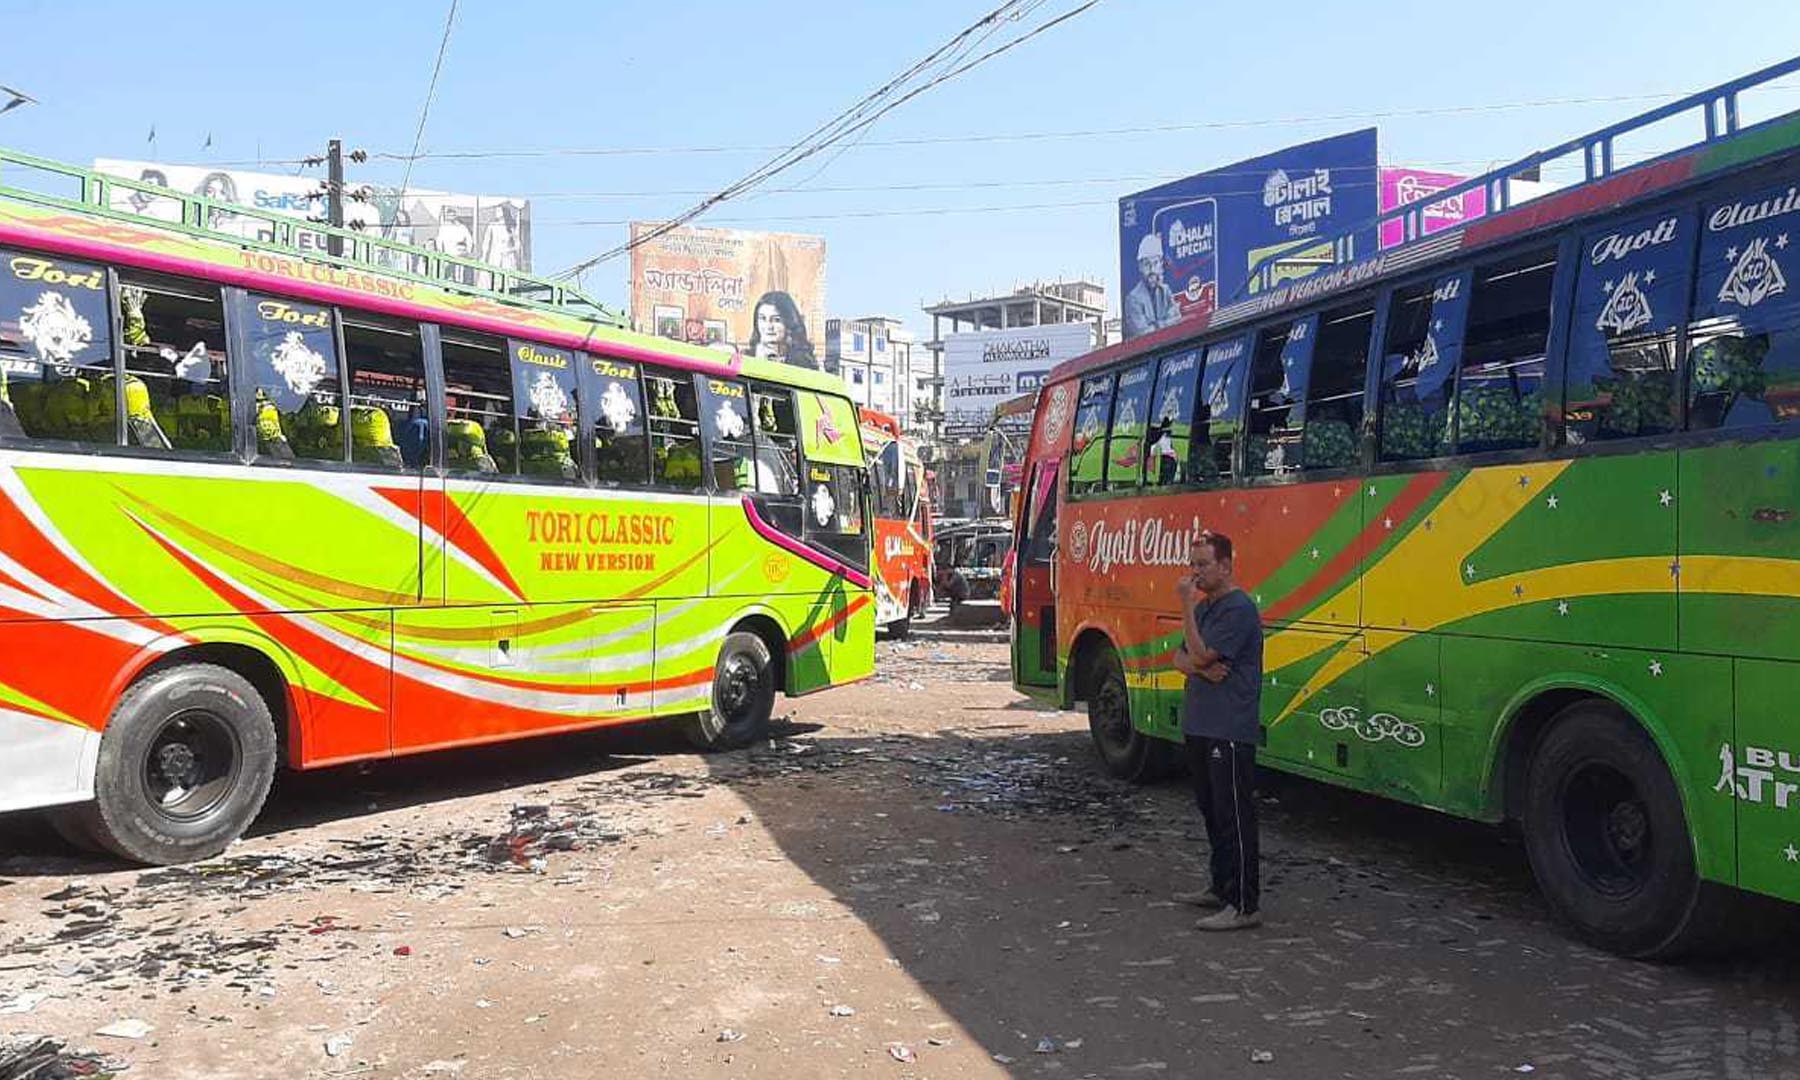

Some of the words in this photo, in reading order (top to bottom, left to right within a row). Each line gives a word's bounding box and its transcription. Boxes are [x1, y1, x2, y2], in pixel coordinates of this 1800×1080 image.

[1176, 223, 1212, 246] DHALAI
[1177, 240, 1213, 259] SPECIAL
[1592, 218, 1679, 265] Jyoti
[10, 257, 103, 291] Tori
[241, 252, 306, 280] TORI
[311, 264, 416, 301] CLASSIC
[258, 301, 329, 327] Tori
[593, 360, 636, 379] Tori
[709, 380, 744, 398] Tori
[527, 511, 582, 544] TORI
[588, 512, 674, 545] CLASSIC
[1089, 519, 1136, 574] Jyoti
[1141, 515, 1207, 566] Classi
[541, 551, 580, 571] NEW
[586, 553, 655, 571] VERSION
[1736, 767, 1798, 808] Tr
